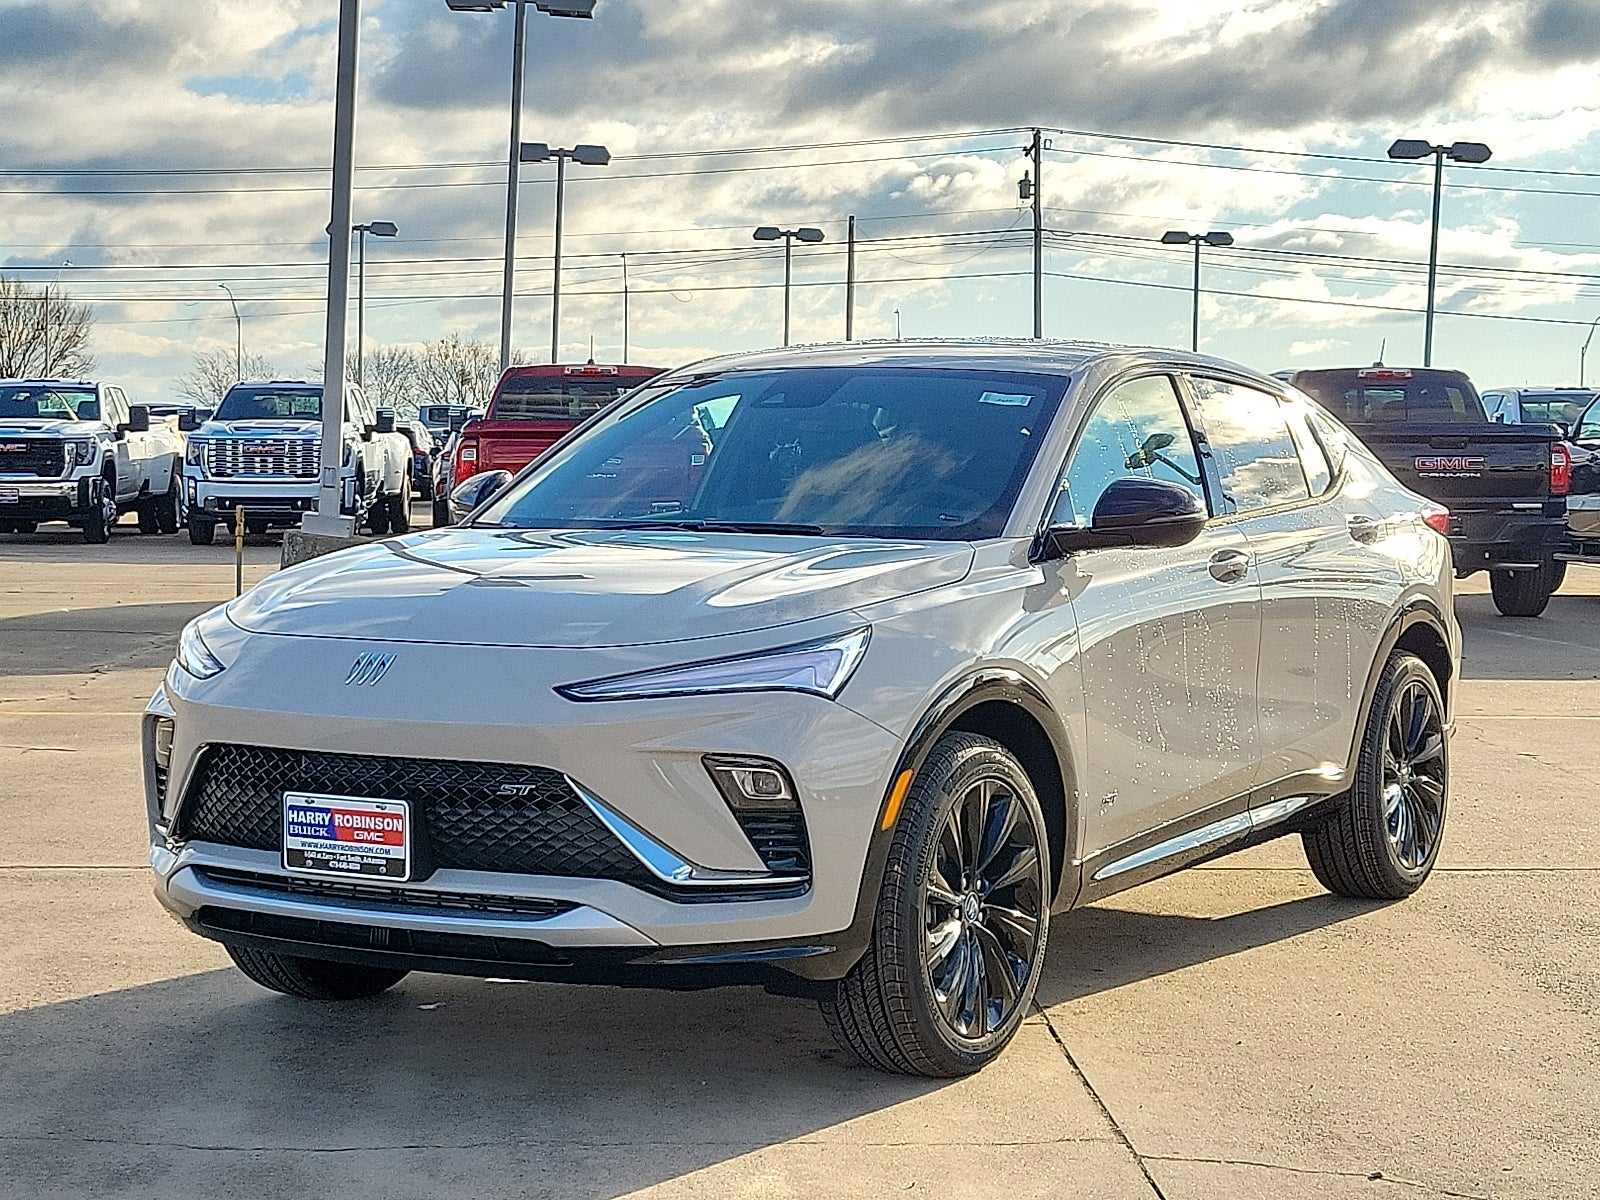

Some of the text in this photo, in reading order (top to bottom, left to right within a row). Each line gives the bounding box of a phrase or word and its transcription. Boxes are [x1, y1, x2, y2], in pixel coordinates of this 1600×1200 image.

[0, 443, 27, 452] MC
[1414, 456, 1485, 470] GMC
[496, 784, 537, 796] ST
[288, 809, 403, 832] HARRY ROBINSON
[289, 824, 385, 842] BUICK GMC
[300, 840, 391, 856] WWW.HARRYROBINSON.COM
